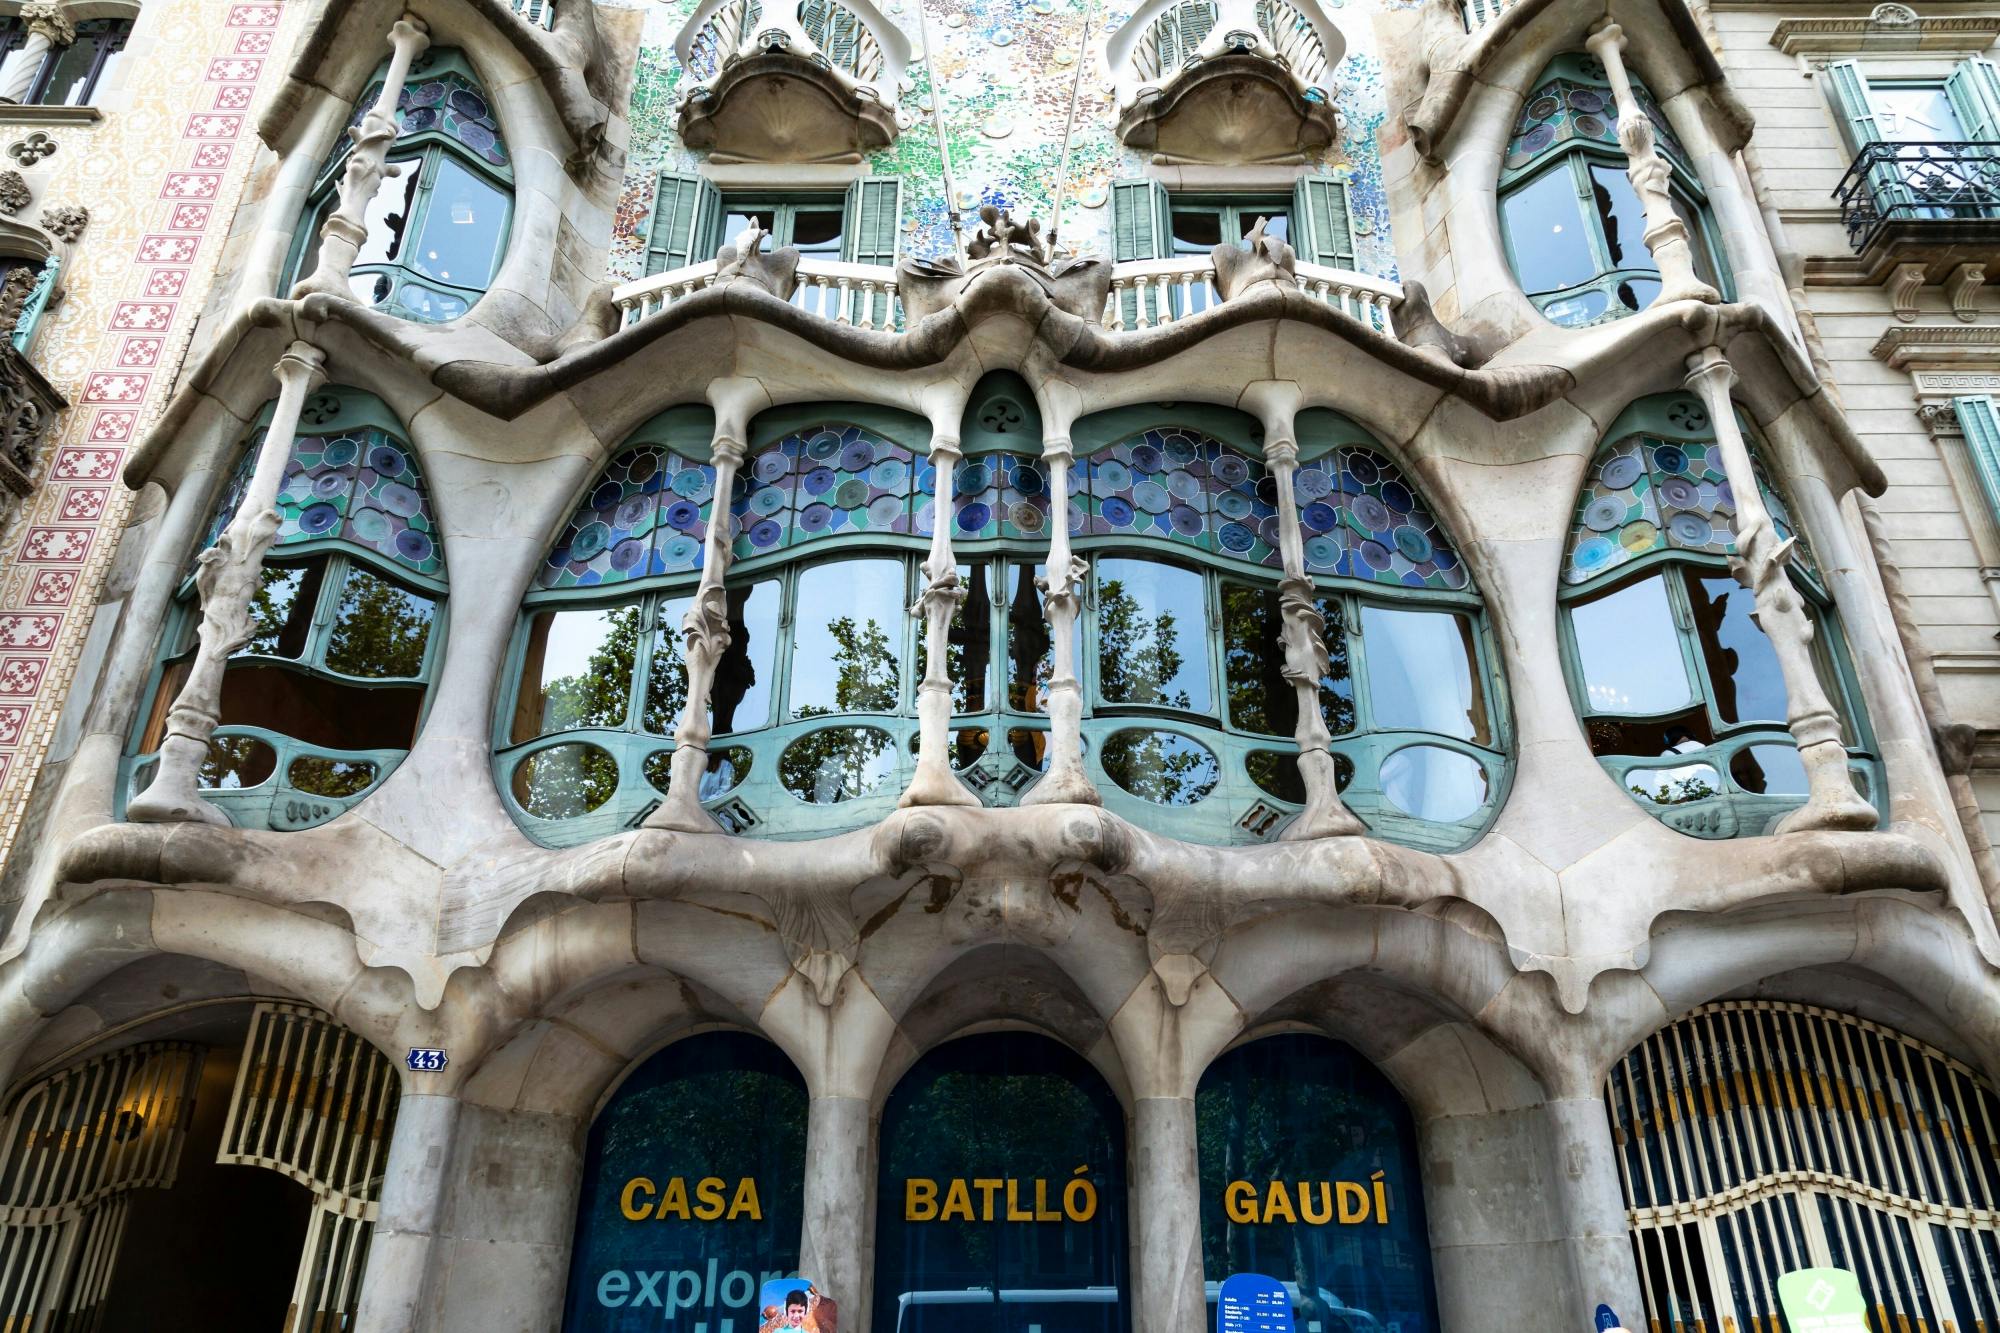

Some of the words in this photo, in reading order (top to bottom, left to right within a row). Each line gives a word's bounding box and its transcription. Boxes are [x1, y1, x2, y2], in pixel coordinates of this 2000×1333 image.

[414, 1051, 441, 1069] 43
[620, 1176, 763, 1221] CASA
[905, 1164, 1098, 1223] BATLLÓ
[1224, 1169, 1389, 1225] GAUDÍ
